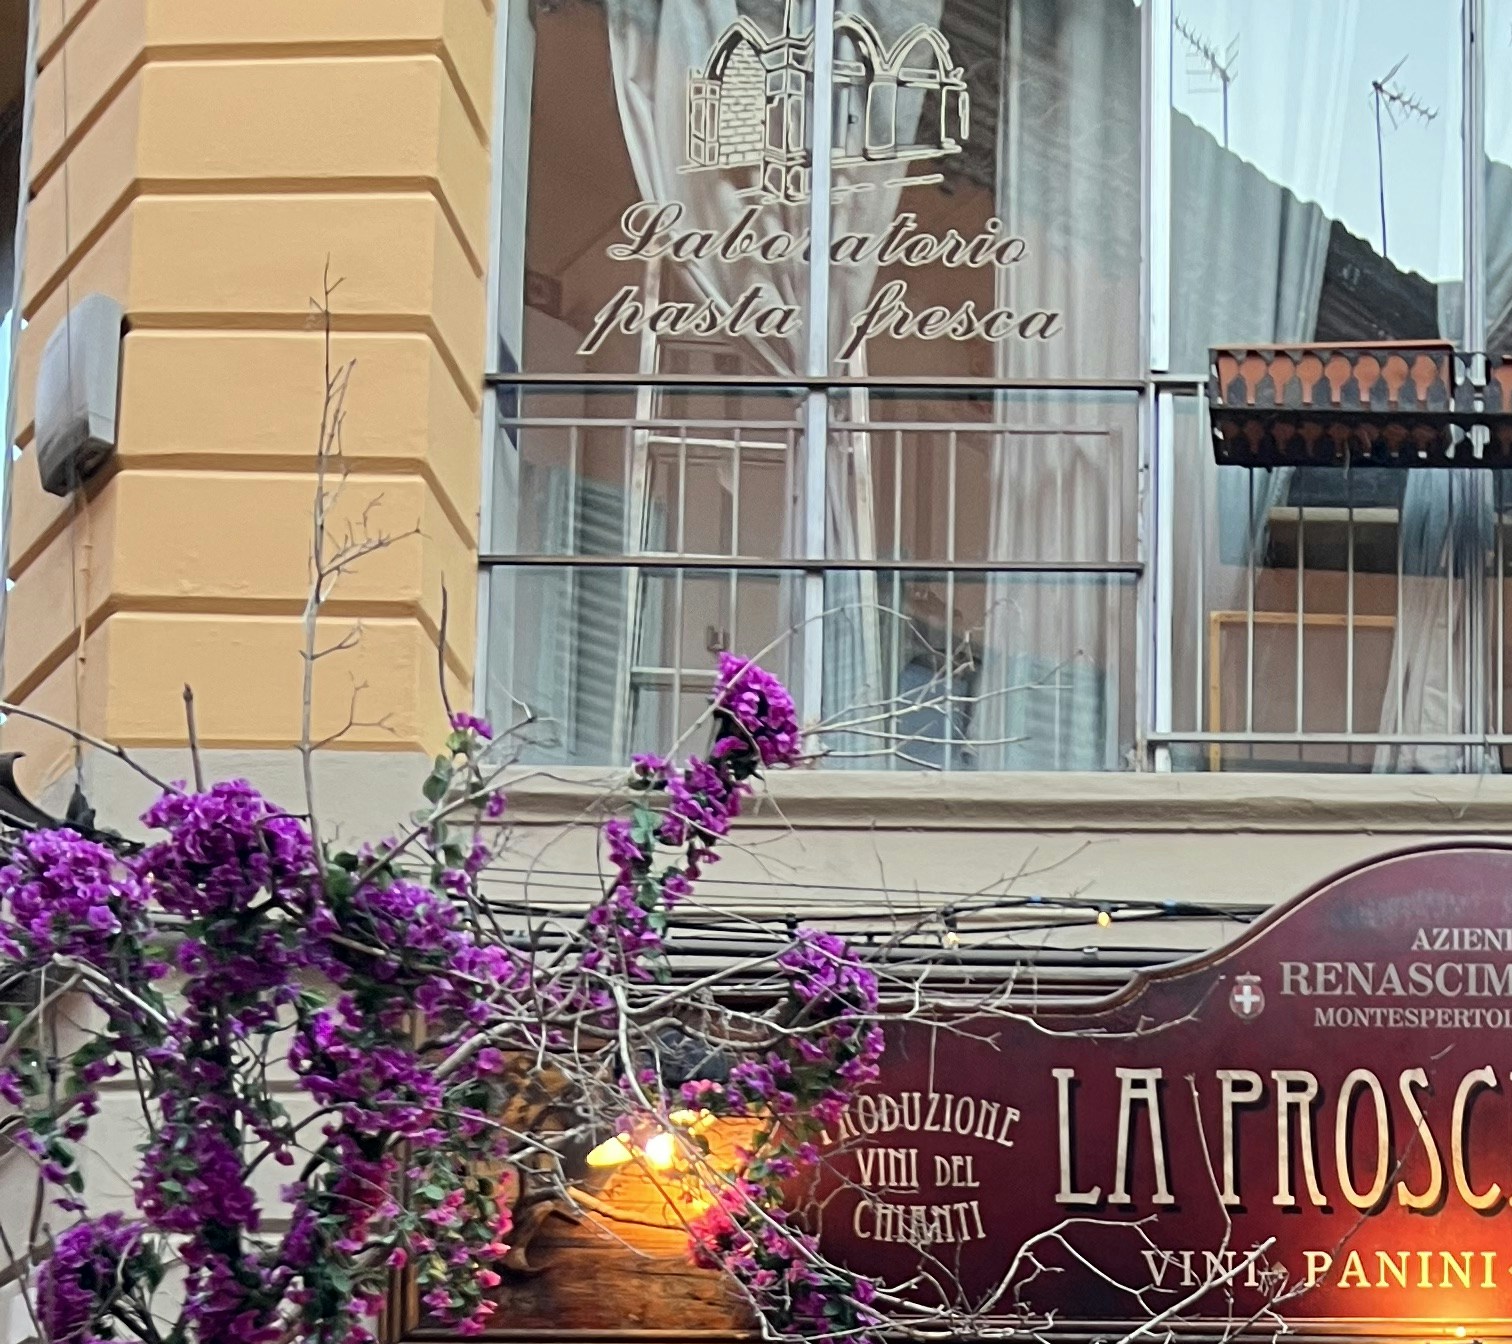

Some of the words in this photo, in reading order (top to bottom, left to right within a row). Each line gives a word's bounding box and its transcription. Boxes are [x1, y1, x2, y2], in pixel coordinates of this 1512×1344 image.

[576, 282, 800, 355] pasta
[835, 280, 1064, 363] fresca
[1051, 1067, 1175, 1206] LA
[857, 1148, 918, 1189] VINI
[935, 1154, 981, 1188] DEL
[852, 1200, 987, 1243] CHIANTI
[1140, 1250, 1258, 1288] VINI
[1304, 1250, 1498, 1290] PANINI
